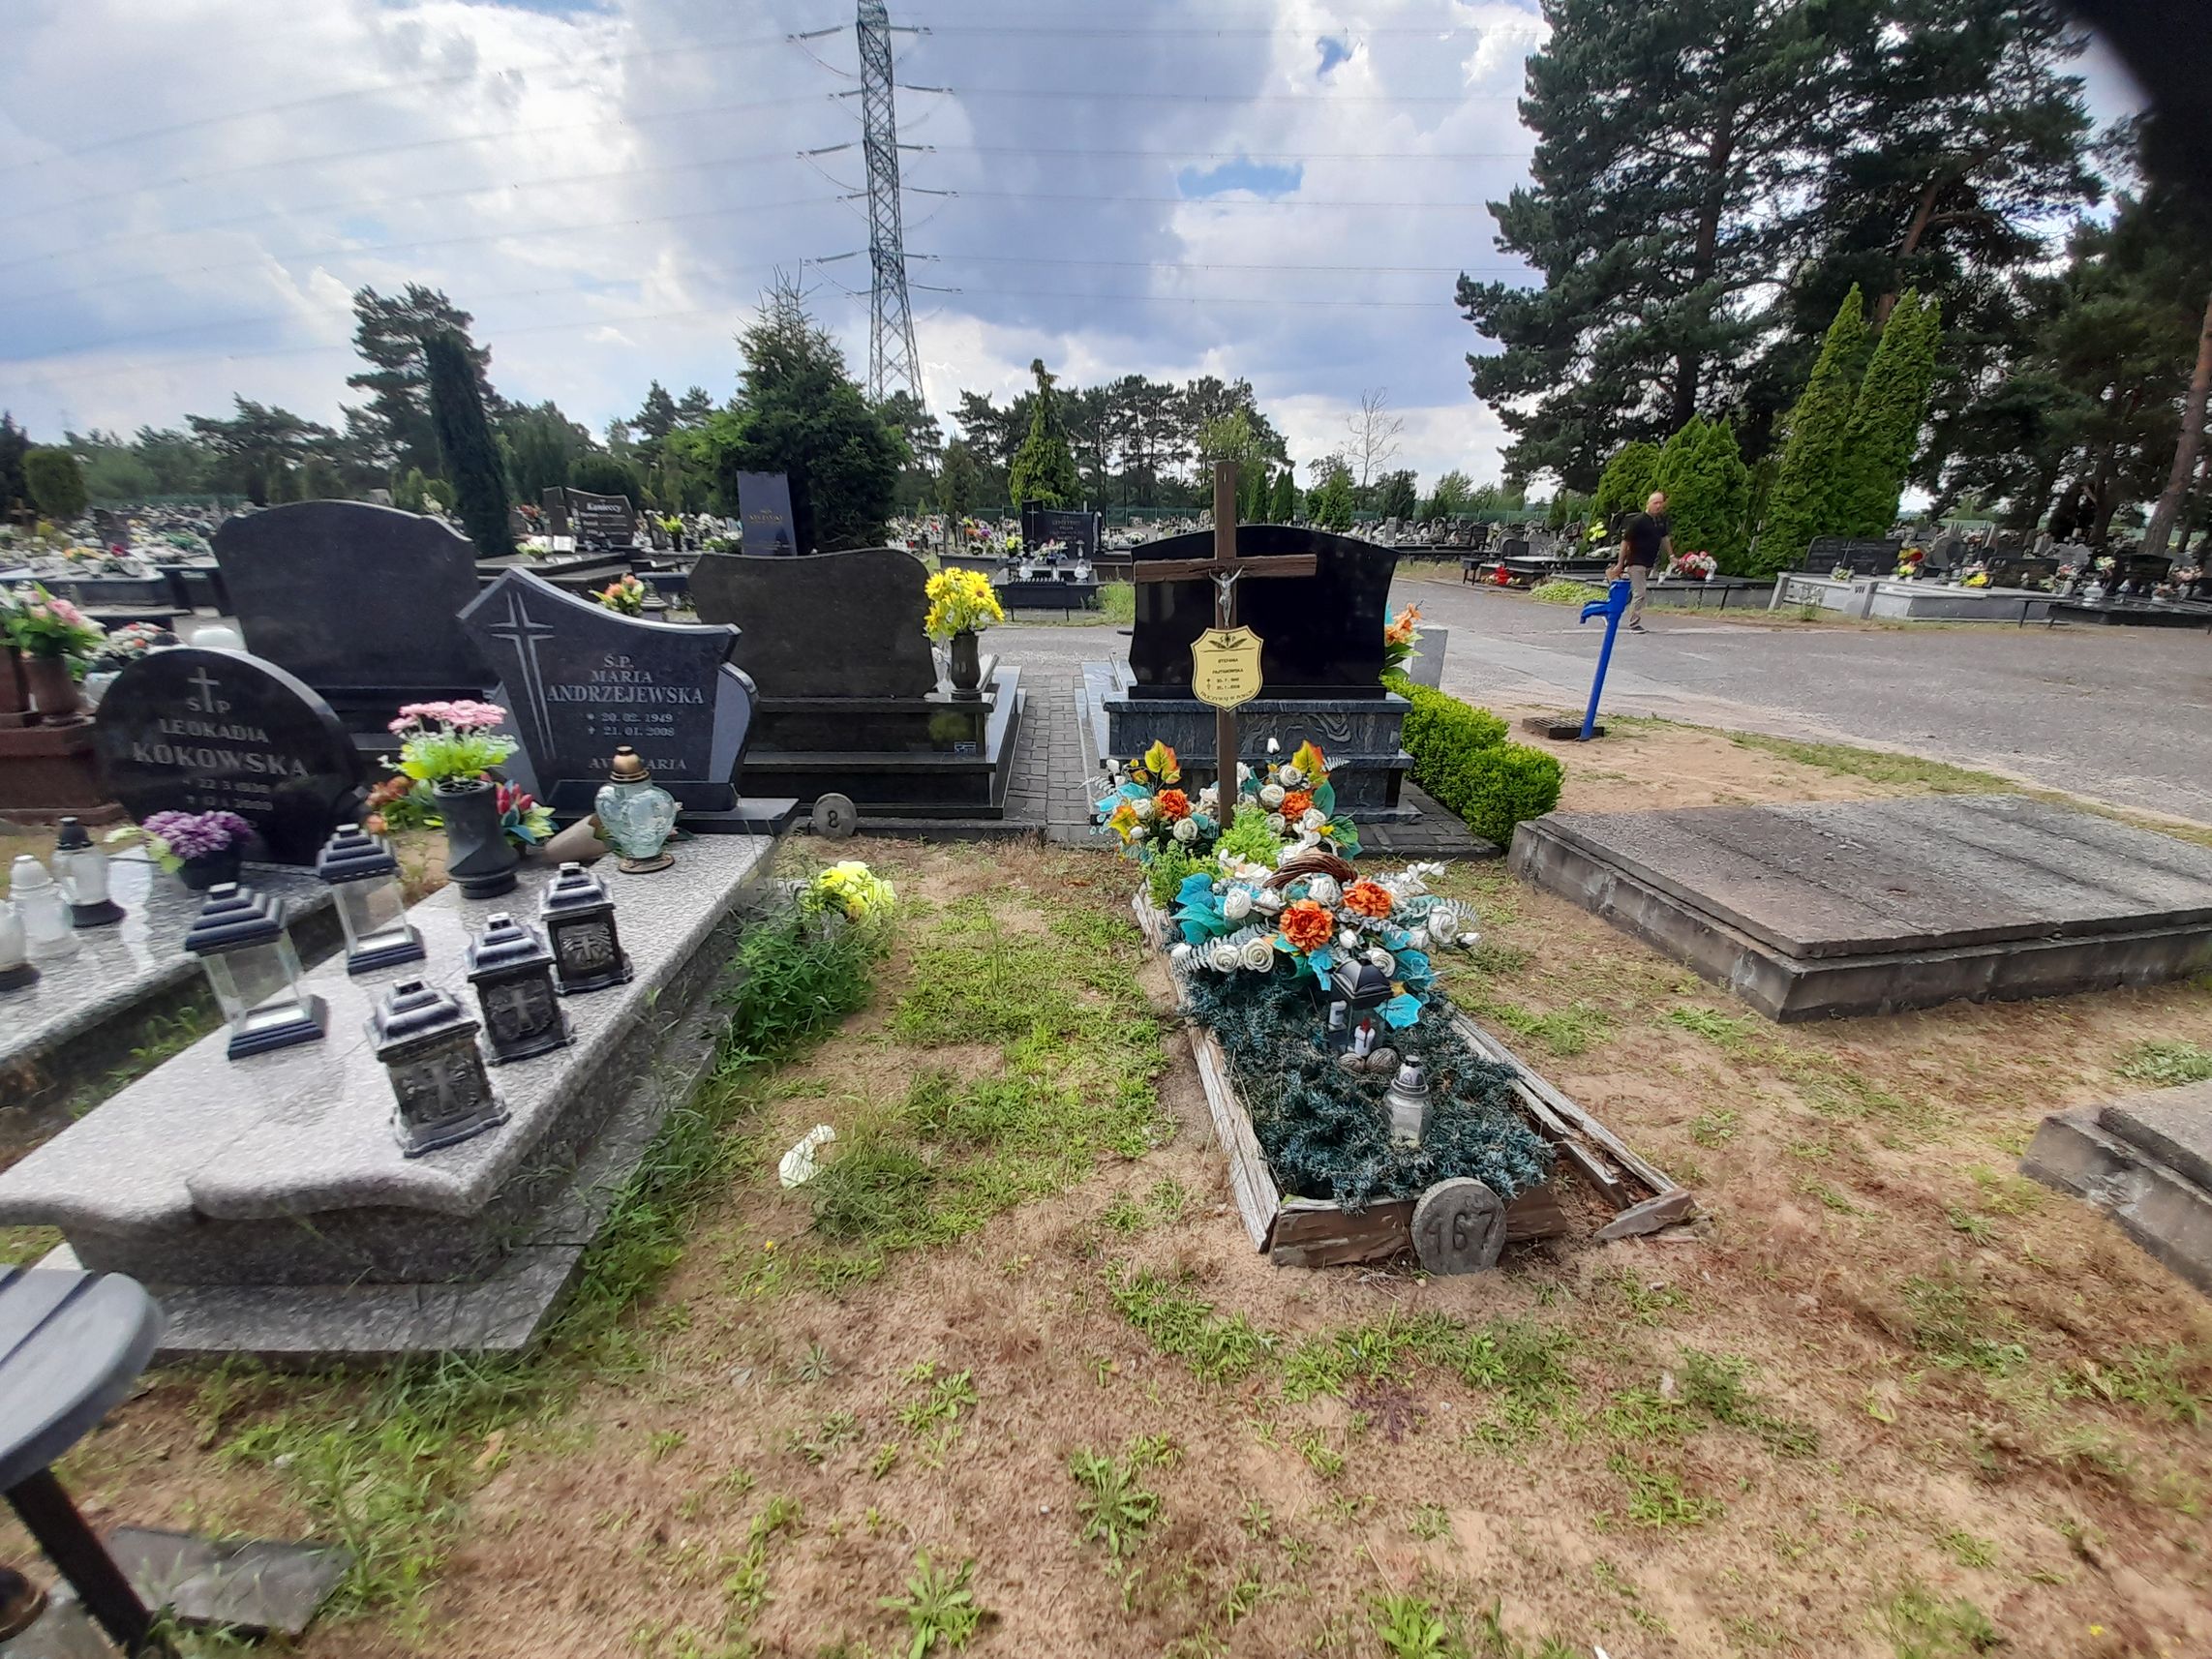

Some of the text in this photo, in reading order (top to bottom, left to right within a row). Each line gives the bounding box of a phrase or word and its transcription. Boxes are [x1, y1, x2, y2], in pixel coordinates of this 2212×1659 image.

[591, 670, 654, 683] MARIA
[547, 684, 705, 705] ANDRZEJEWSKA
[216, 699, 231, 714] P
[158, 718, 270, 743] LEOKADIA
[133, 741, 310, 778] KOKOWSKA
[828, 809, 839, 829] 8
